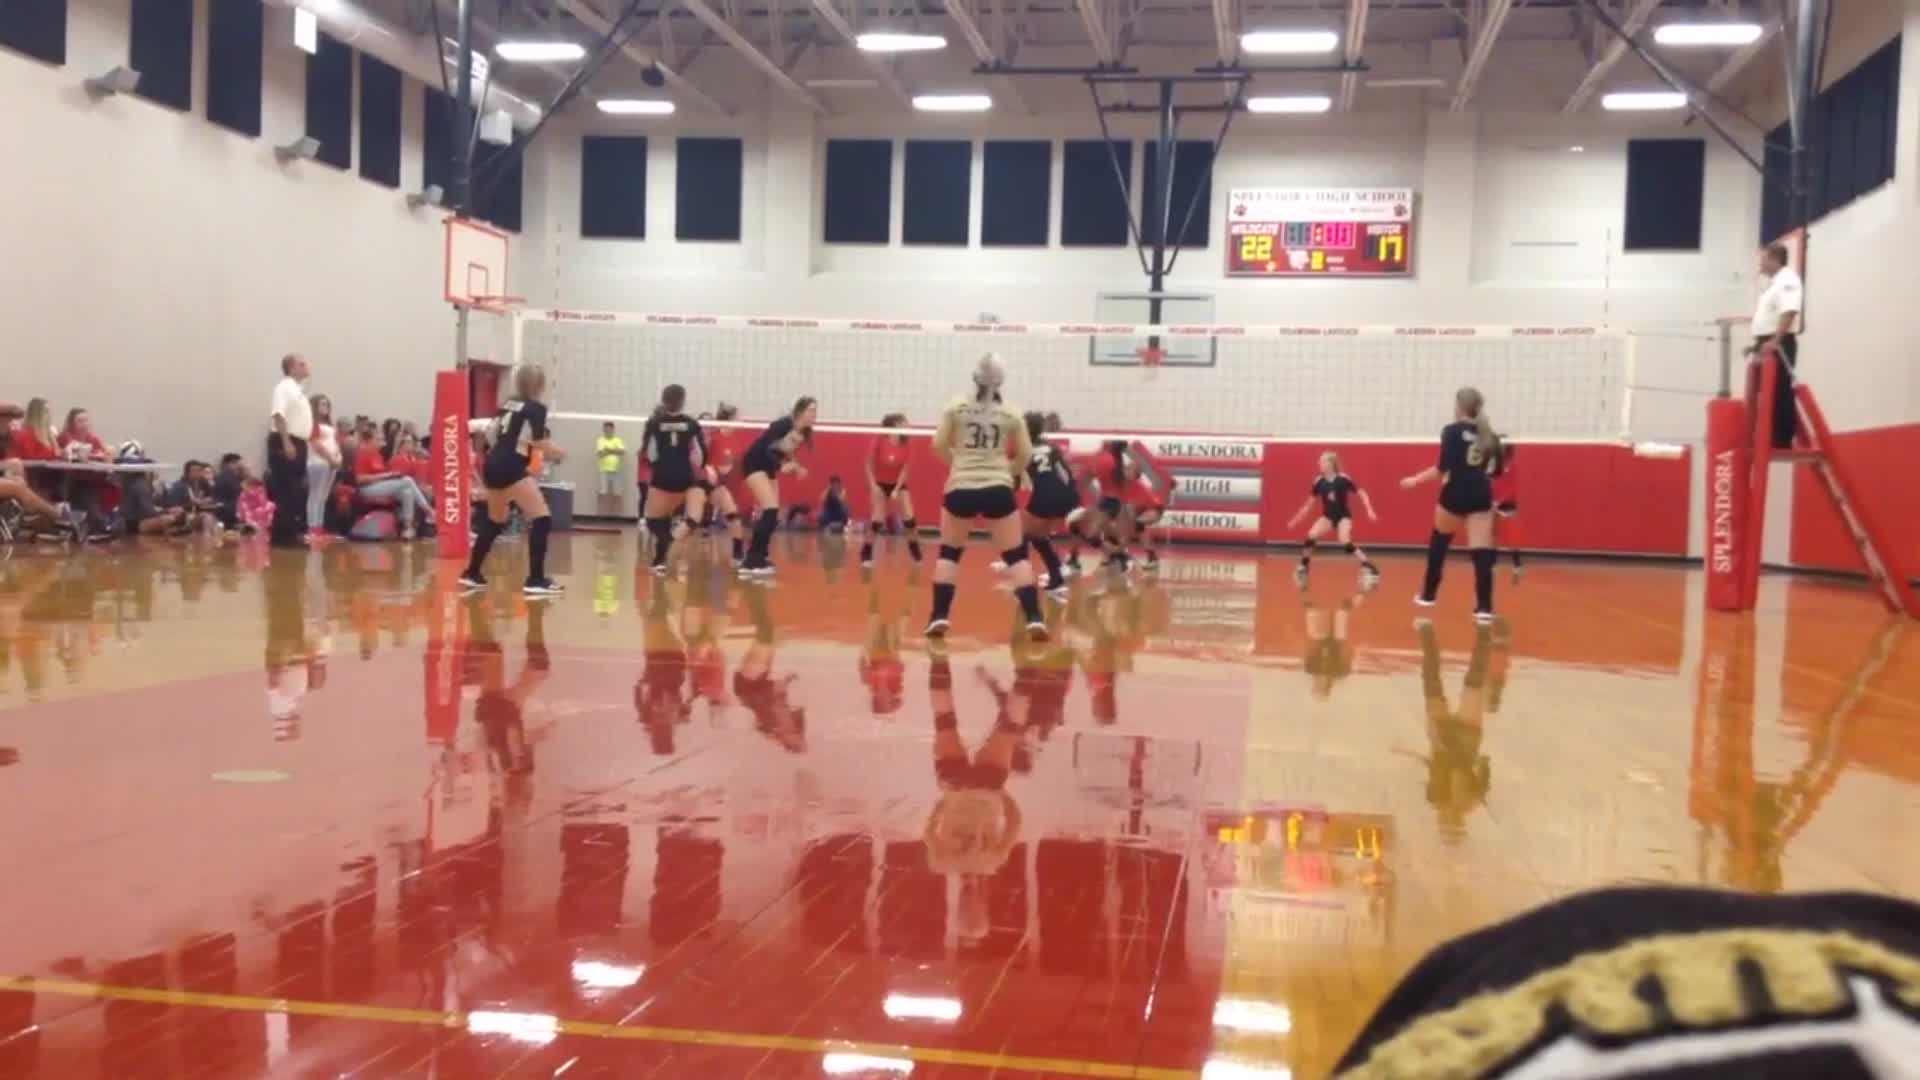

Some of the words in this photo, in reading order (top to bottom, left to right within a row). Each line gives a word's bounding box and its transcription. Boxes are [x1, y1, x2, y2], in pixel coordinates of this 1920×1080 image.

[1241, 235, 1272, 261] 22
[1379, 235, 1403, 262] 17
[1158, 443, 1258, 459] SPLENDORA
[443, 415, 460, 525] SPLENDORA
[1184, 479, 1232, 494] HIGH
[1169, 514, 1242, 529] SCHOOL
[1713, 449, 1734, 574] SPLENDORA
